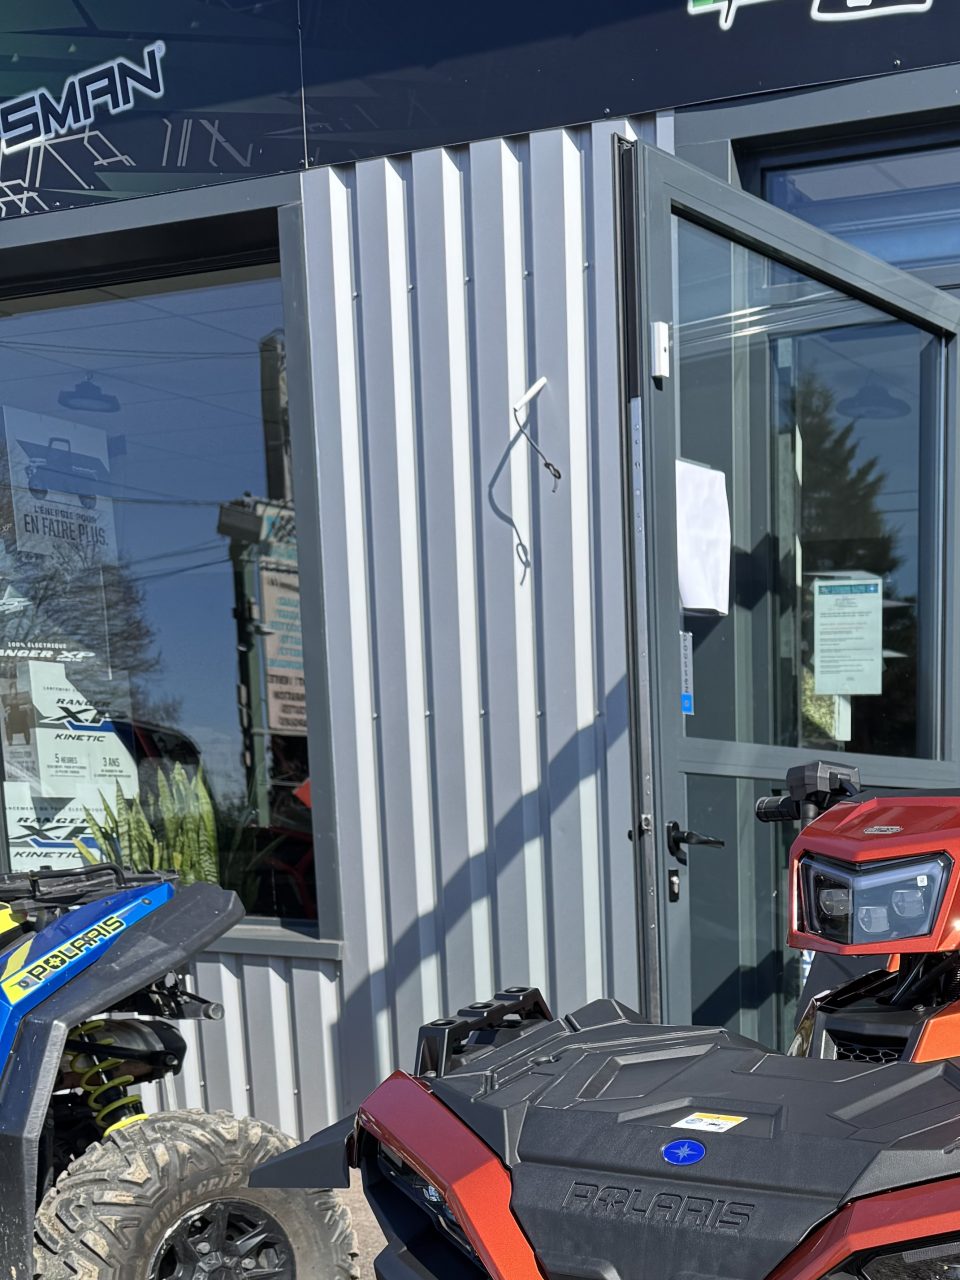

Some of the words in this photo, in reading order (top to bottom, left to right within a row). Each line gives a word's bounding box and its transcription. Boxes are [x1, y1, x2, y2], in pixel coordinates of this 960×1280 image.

[24, 514, 40, 535] EN
[42, 519, 76, 541] FAIRE
[78, 523, 109, 546] PLUS.
[57, 650, 95, 660] XP
[56, 698, 111, 707] RANGER
[54, 733, 106, 743] KINETIC
[108, 758, 120, 768] ANS
[13, 851, 83, 859] KINETIC
[26, 915, 126, 982] POLARIS
[561, 1180, 756, 1235] POLARIS
